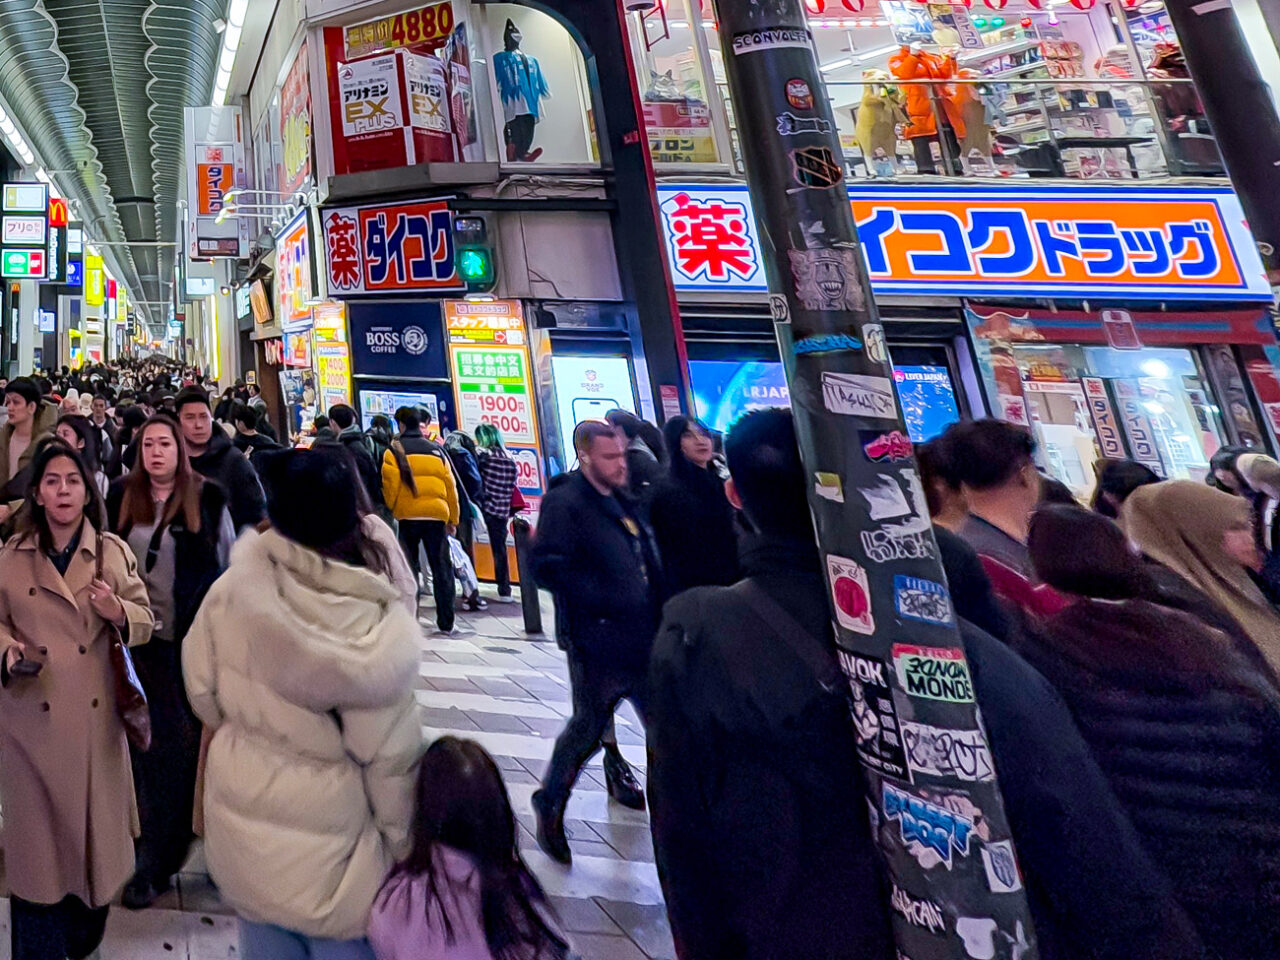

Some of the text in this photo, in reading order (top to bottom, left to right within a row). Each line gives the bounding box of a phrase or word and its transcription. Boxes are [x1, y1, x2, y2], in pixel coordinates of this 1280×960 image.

[391, 1, 455, 45] 4880
[344, 82, 389, 102] アリナミン
[345, 96, 390, 123] EX
[327, 211, 455, 287] 薬 ダイコク
[671, 192, 756, 279] 薬
[366, 332, 400, 346] BOSS
[478, 395, 525, 413] 1900円
